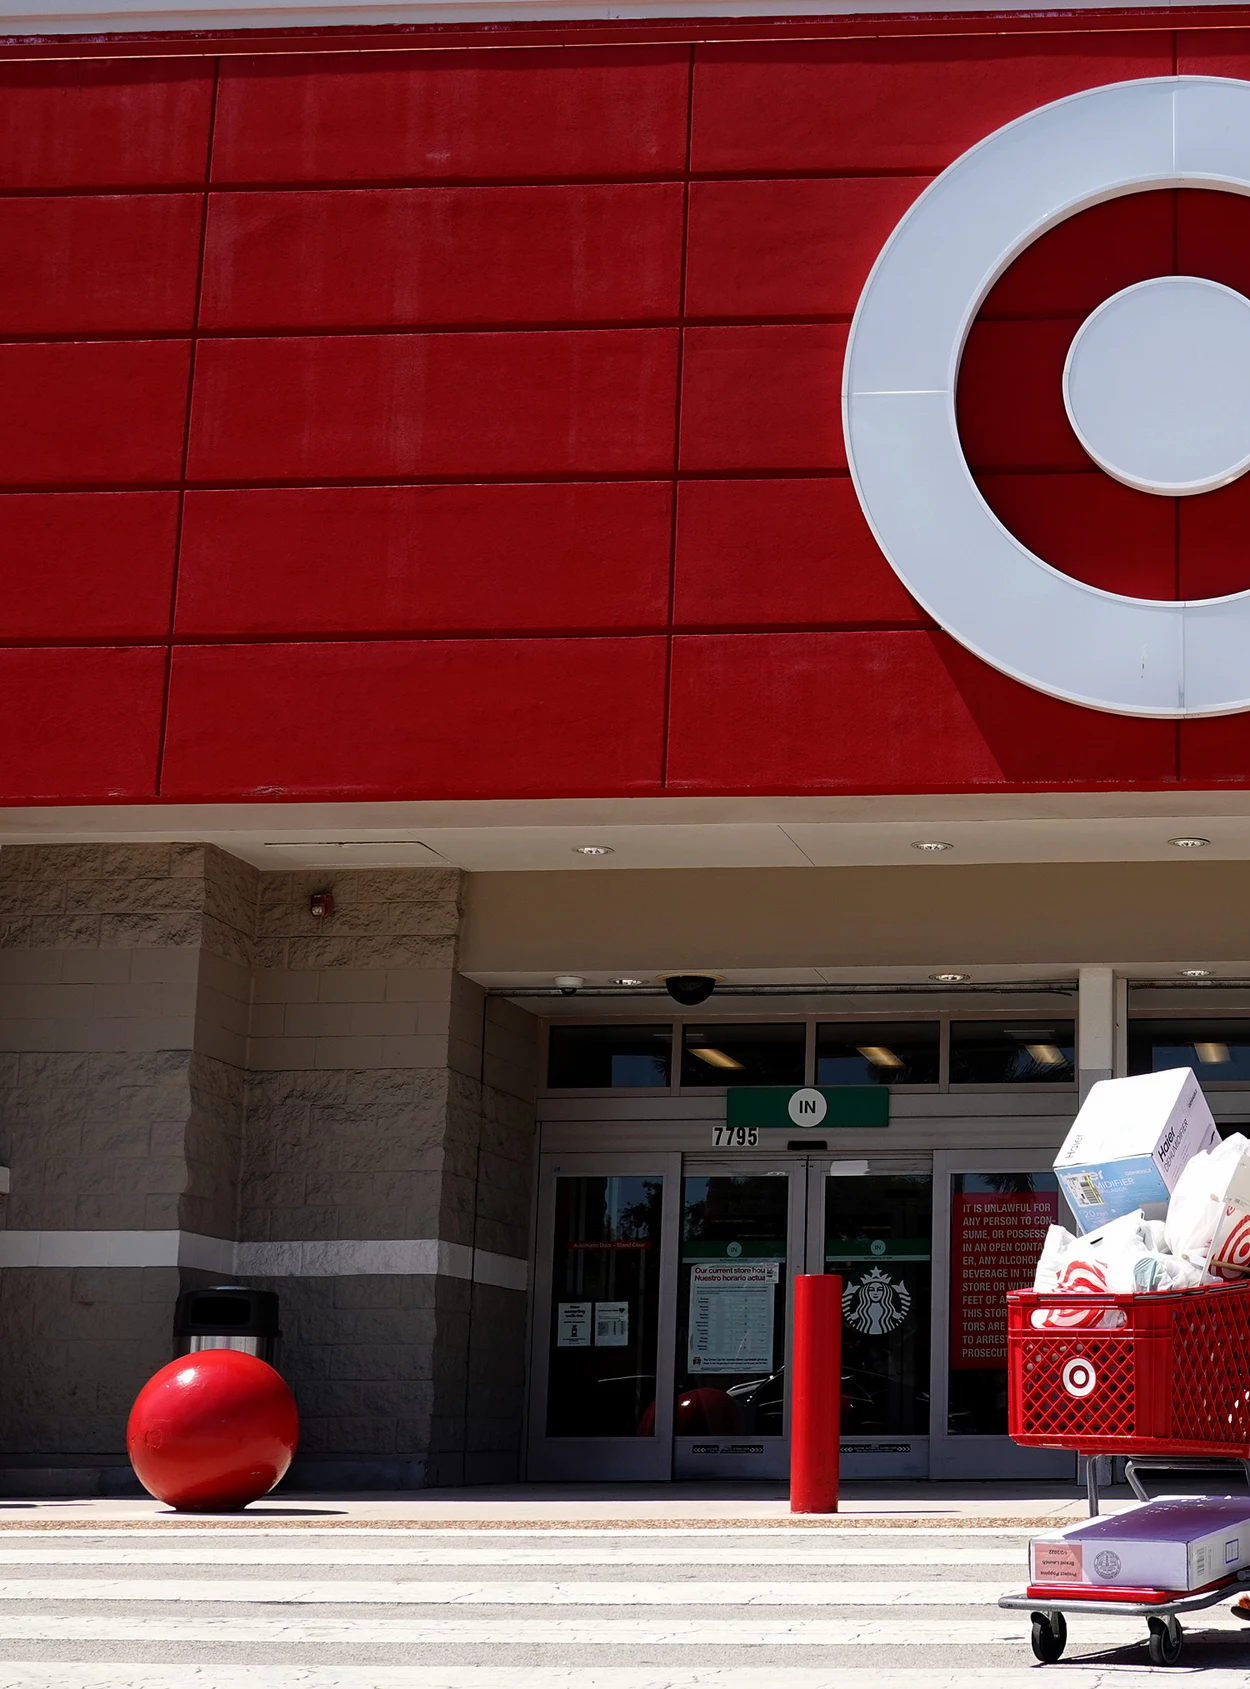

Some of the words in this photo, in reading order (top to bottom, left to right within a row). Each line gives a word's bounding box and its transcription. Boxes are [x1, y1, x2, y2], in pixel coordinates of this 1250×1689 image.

[799, 1100, 816, 1114] IN
[714, 1127, 758, 1146] 7795
[1064, 1134, 1084, 1159] Haier
[1158, 1126, 1176, 1162] Haier
[1163, 1118, 1189, 1173] DEHUMIDIFIER
[963, 1204, 972, 1213] IT
[973, 1204, 982, 1212] IS
[984, 1203, 1031, 1212] UNLAWFUL
[1034, 1203, 1051, 1212] FOR
[1084, 1209, 1096, 1219] 20
[963, 1217, 981, 1226] ANY
[983, 1216, 1018, 1226] PERSON
[1020, 1216, 1031, 1225] TO
[1034, 1216, 1056, 1225] CON-
[963, 1230, 990, 1240] SUME,
[992, 1230, 1004, 1239] OR
[1006, 1229, 1046, 1238] POSSESS
[963, 1243, 972, 1252] IN
[974, 1243, 986, 1252] AN
[989, 1243, 1012, 1252] OPEN
[1014, 1242, 1044, 1251] CONTA
[963, 1256, 977, 1266] ER,
[978, 1256, 996, 1265] ANY
[998, 1256, 1038, 1265] ALCOHOL
[963, 1269, 1008, 1278] BEVERAGE
[1010, 1269, 1020, 1278] IN
[1022, 1269, 1036, 1277] THI
[962, 1282, 991, 1291] STORE
[993, 1282, 1005, 1291] OR
[1007, 1282, 1034, 1291] WITHI
[963, 1295, 984, 1304] FEET
[986, 1295, 997, 1304] OF
[963, 1308, 982, 1318] THIS
[984, 1308, 1008, 1318] STOR
[962, 1322, 985, 1331] TORS
[987, 1322, 1005, 1331] ARE
[962, 1335, 974, 1344] TO
[962, 1348, 1008, 1358] PROSECUT
